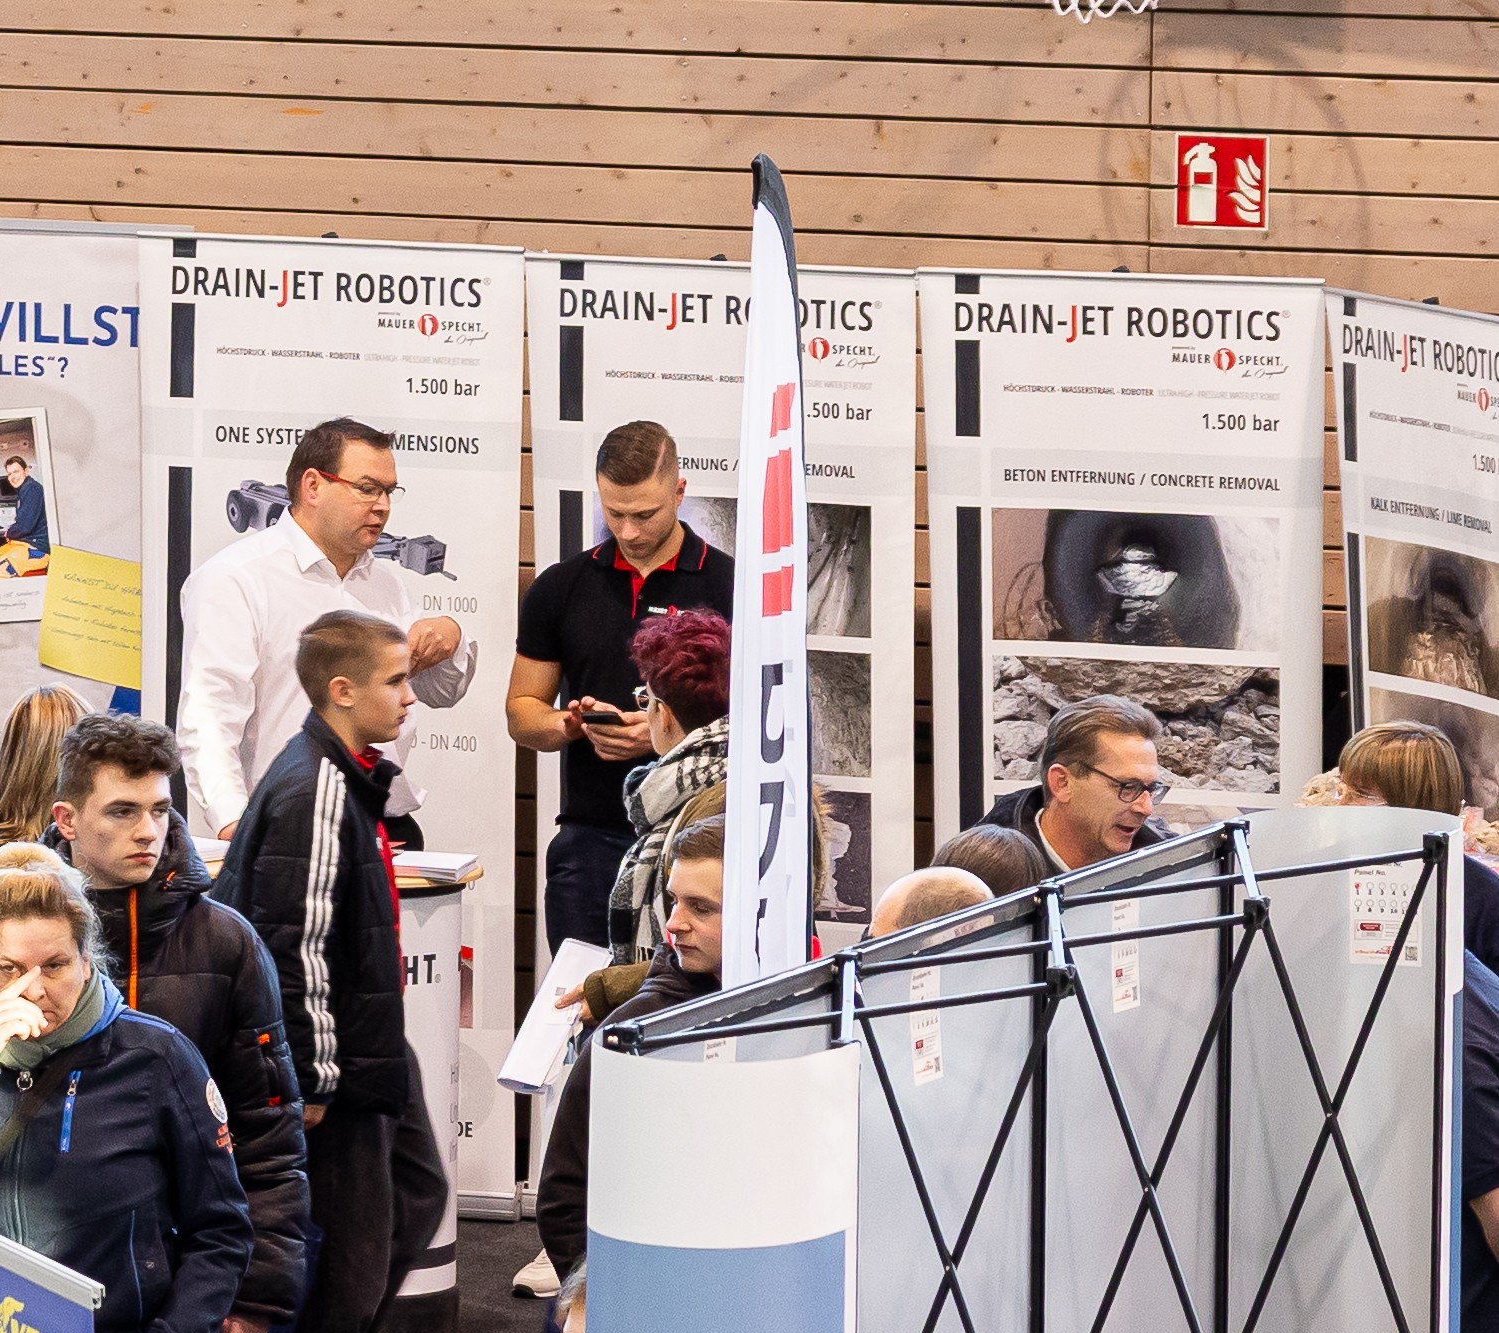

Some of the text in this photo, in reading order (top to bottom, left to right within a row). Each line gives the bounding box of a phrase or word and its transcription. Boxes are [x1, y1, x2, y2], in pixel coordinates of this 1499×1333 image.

[172, 266, 481, 307] DRAIN-JET ROBOTICS
[378, 318, 415, 330] MAUER
[955, 302, 1281, 343] DRAIN-JET ROBOTICS
[1343, 324, 1427, 373] DRAIN-JET
[406, 378, 480, 397] 1.500 bar
[216, 426, 250, 443] ONE
[1004, 469, 1280, 491] BETON ENTFERNUNG CONCRETE REMOVAL
[1371, 497, 1388, 512] KALK
[1391, 499, 1440, 521] ENTFERNUNG
[1464, 514, 1492, 534] REMOVAL
[423, 596, 477, 613] DN 1000
